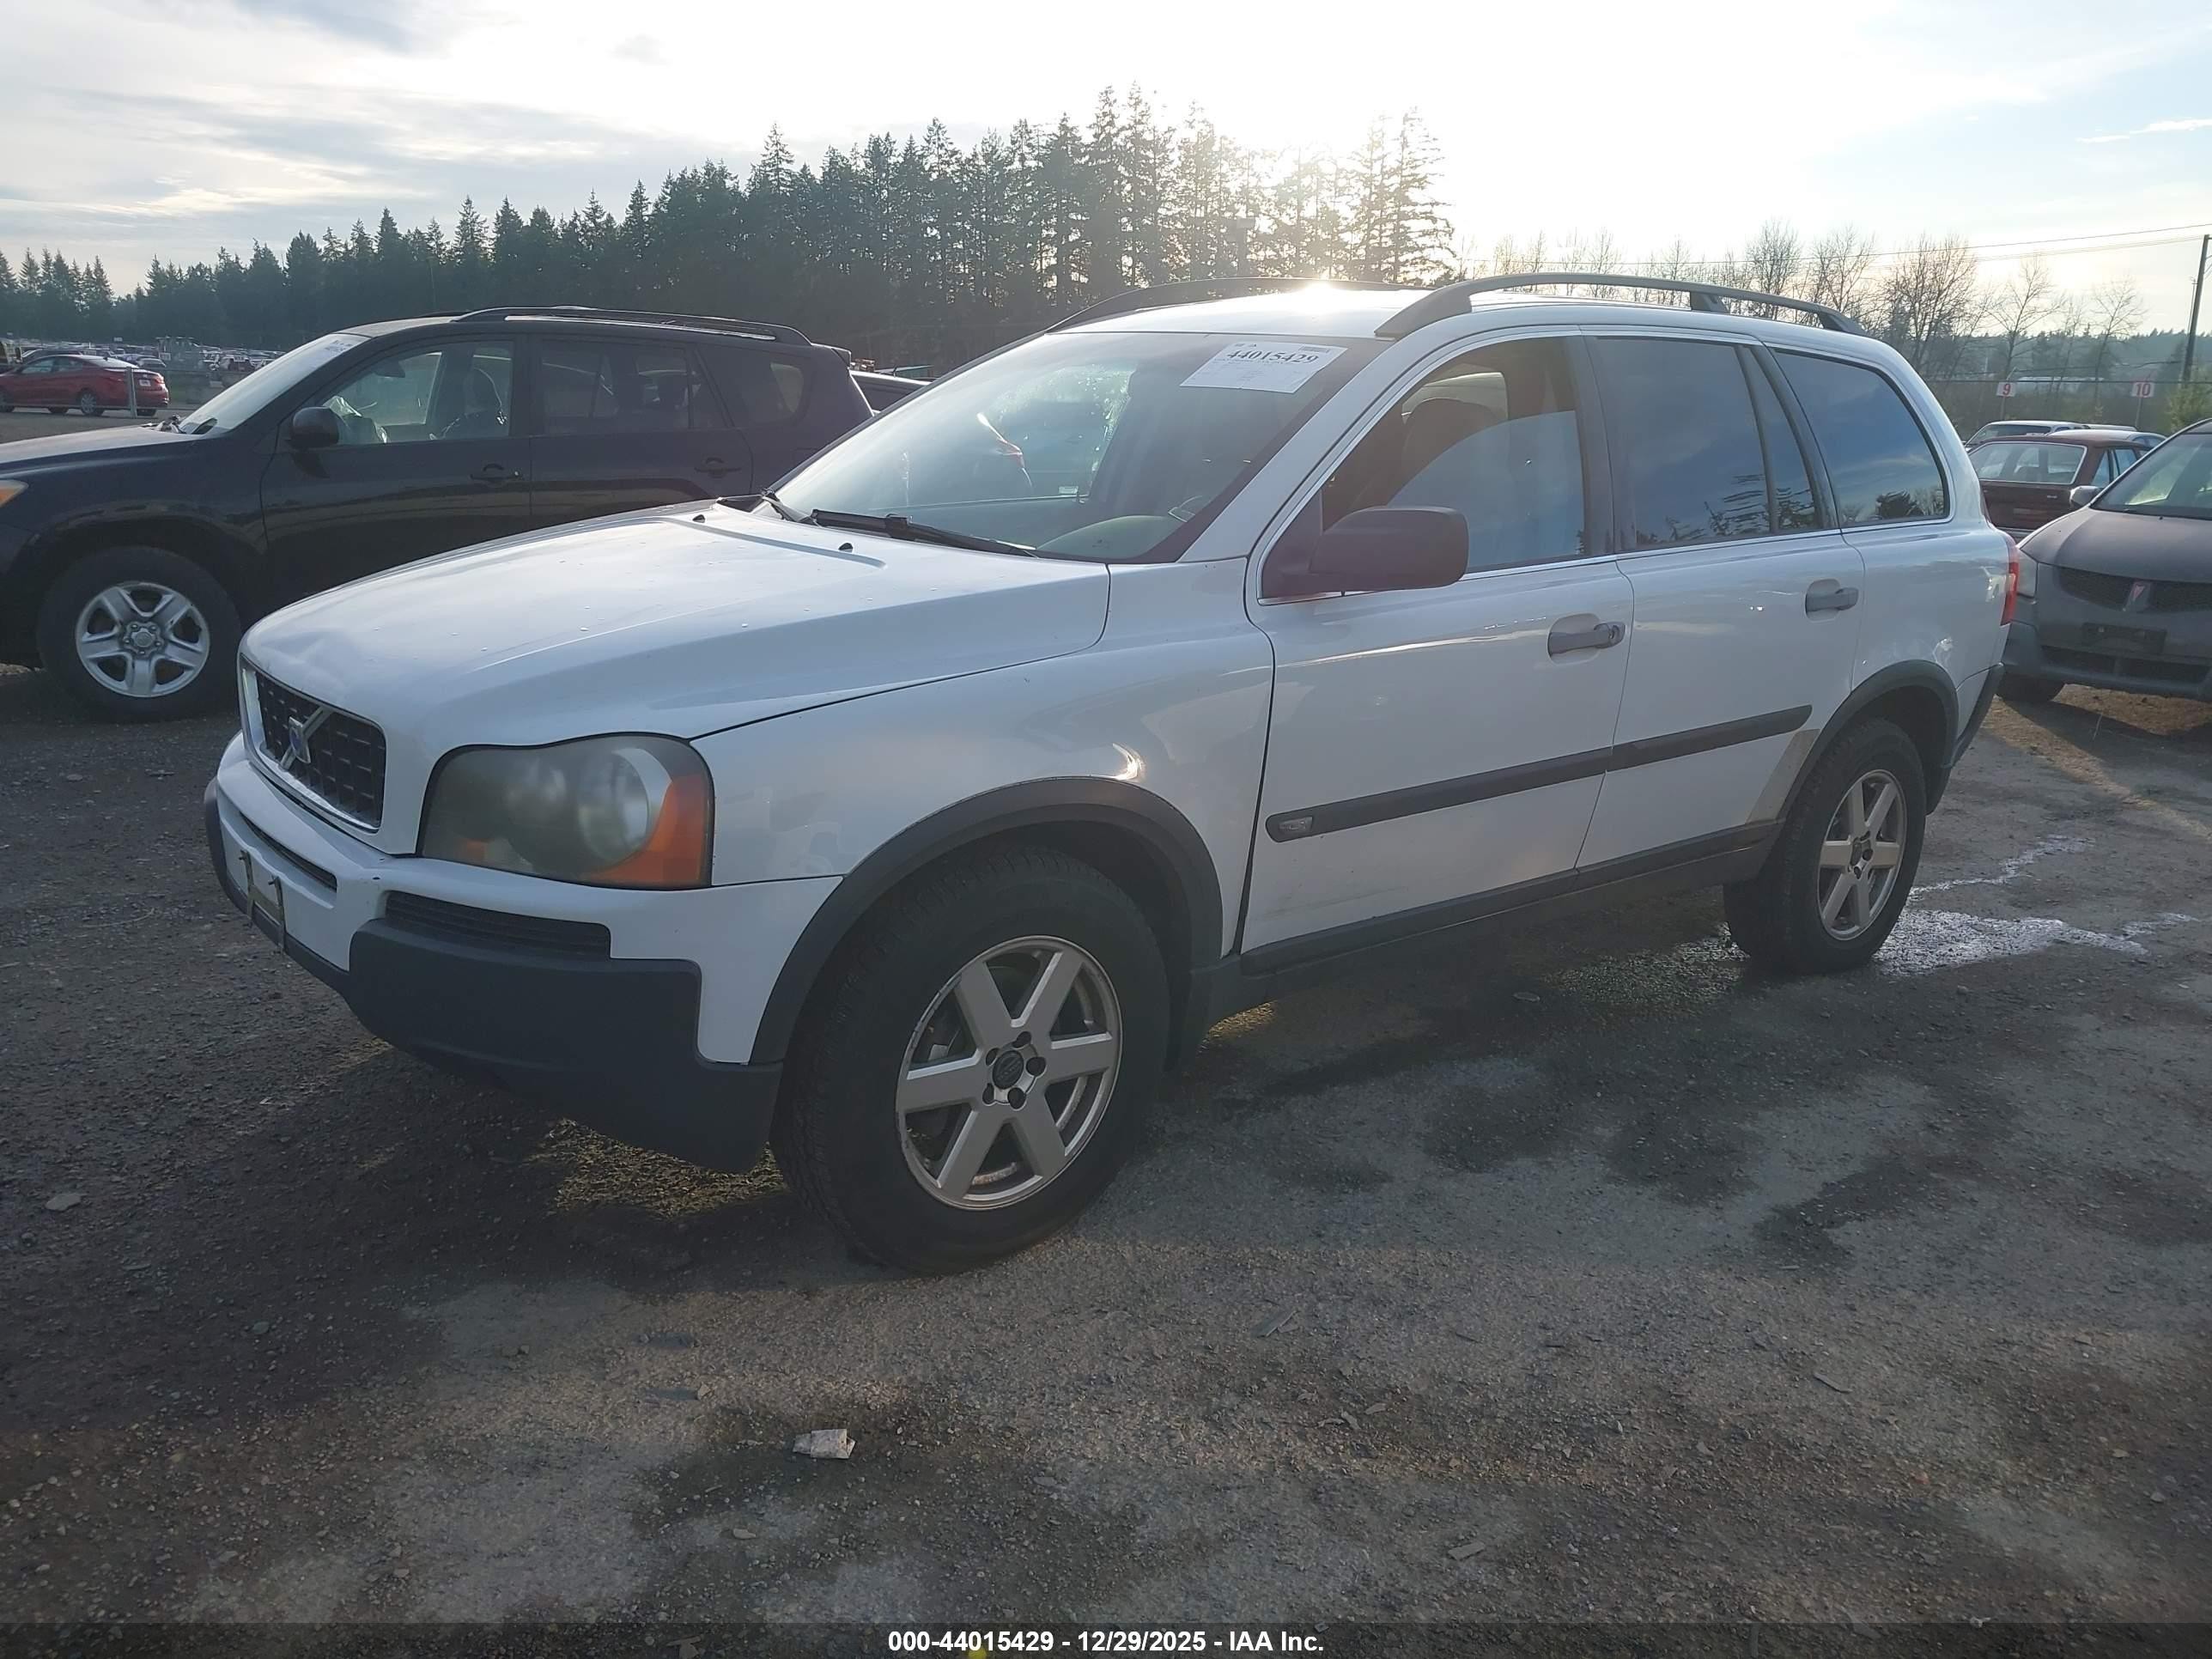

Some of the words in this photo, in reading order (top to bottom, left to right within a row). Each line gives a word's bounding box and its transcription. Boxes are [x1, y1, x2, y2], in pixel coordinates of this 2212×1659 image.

[1226, 349, 1319, 364] 44015429
[2002, 383, 2011, 396] 9
[2136, 382, 2151, 397] 10
